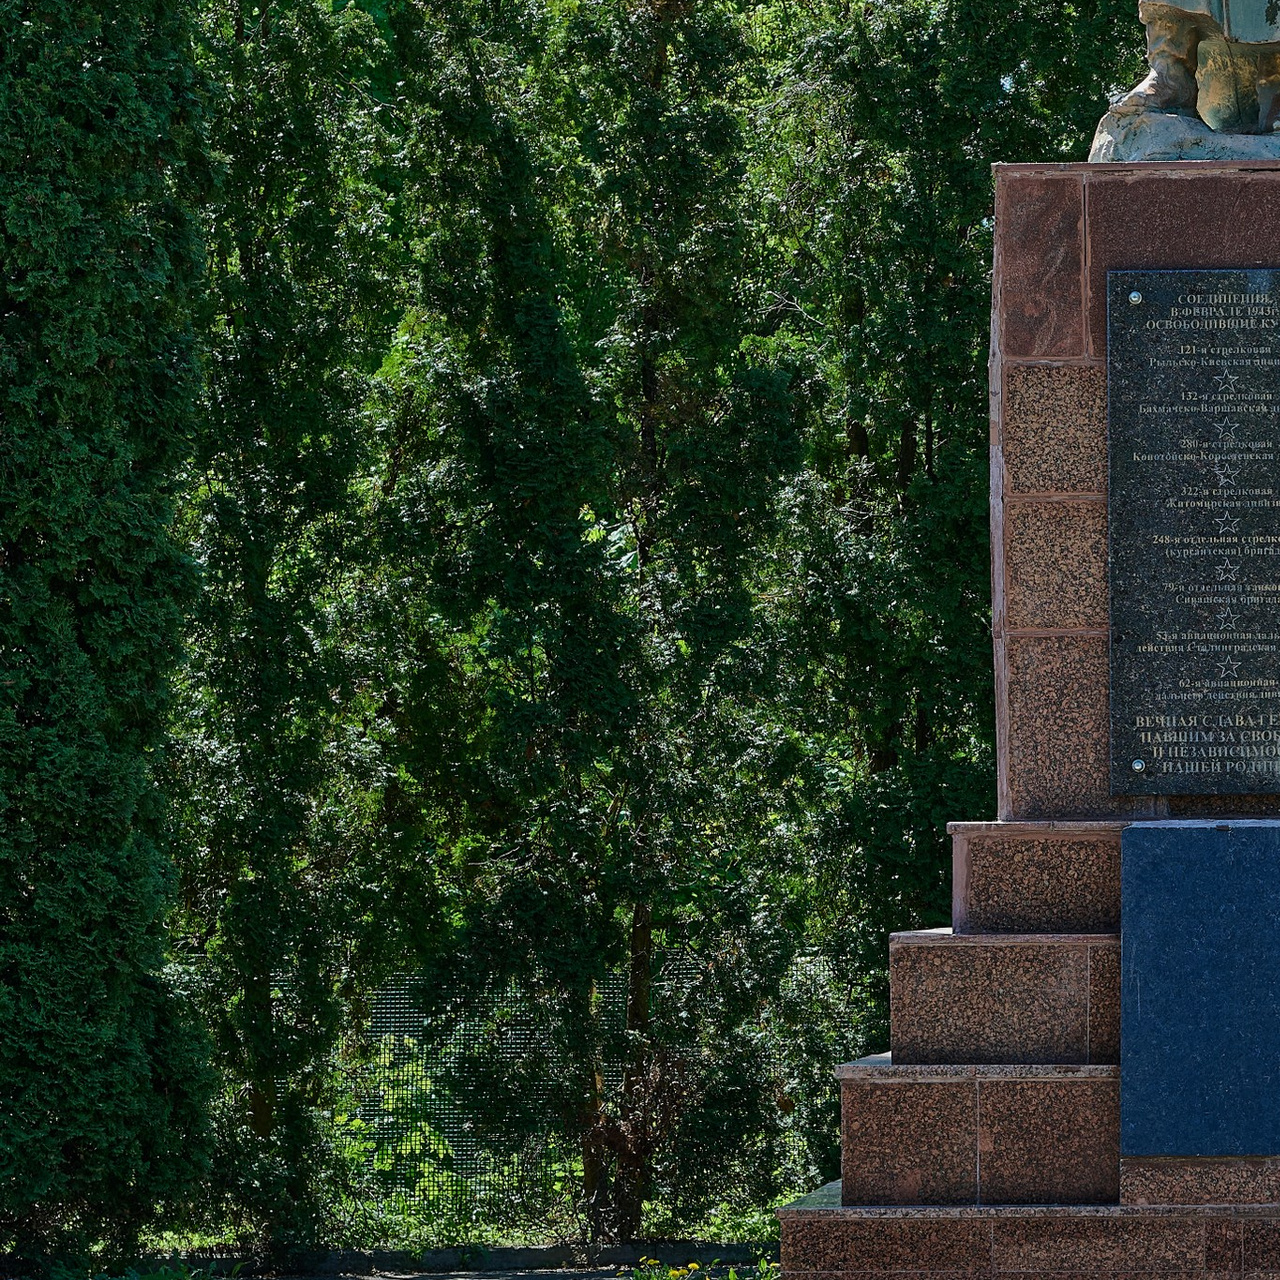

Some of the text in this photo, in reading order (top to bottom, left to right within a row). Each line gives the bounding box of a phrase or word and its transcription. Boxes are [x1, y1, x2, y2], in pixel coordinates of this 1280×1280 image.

[1178, 294, 1269, 304] СОЕДИНЕНИЯ
[1171, 307, 1178, 317] В
[1181, 307, 1243, 317] ФЕВРАЛЕ
[1146, 319, 1257, 330] ОСВОБОДИВШИЕ
[1178, 346, 1271, 356] 121-я стрелковая
[1149, 358, 1251, 367] Рыльско-Киевская
[1180, 392, 1273, 402] 132-я стрелковая
[1180, 439, 1273, 450] 280-я стрелковая
[1180, 487, 1273, 498] 322-я стрелковая
[1166, 499, 1241, 509] Житомирская
[1152, 535, 1181, 544] 248-я
[1183, 535, 1238, 545] отдельная
[1162, 582, 1185, 592] 79-я
[1188, 583, 1243, 593] отдельная
[1175, 595, 1239, 604] Сивашская
[1181, 632, 1250, 641] авиационная
[1135, 643, 1184, 653] действия
[1187, 643, 1277, 653] Сталинградская
[1179, 678, 1275, 688] 62-я авиационная
[1155, 691, 1204, 701] дальнего
[1207, 690, 1255, 700] действия
[1135, 715, 1197, 728] ВЕЧНАЯ
[1202, 715, 1253, 727] СЛАВА
[1140, 731, 1215, 743] ПАВШИМ
[1218, 731, 1235, 743] ЗА
[1152, 746, 1163, 758] И
[1162, 759, 1222, 773] НАШЕЙ
